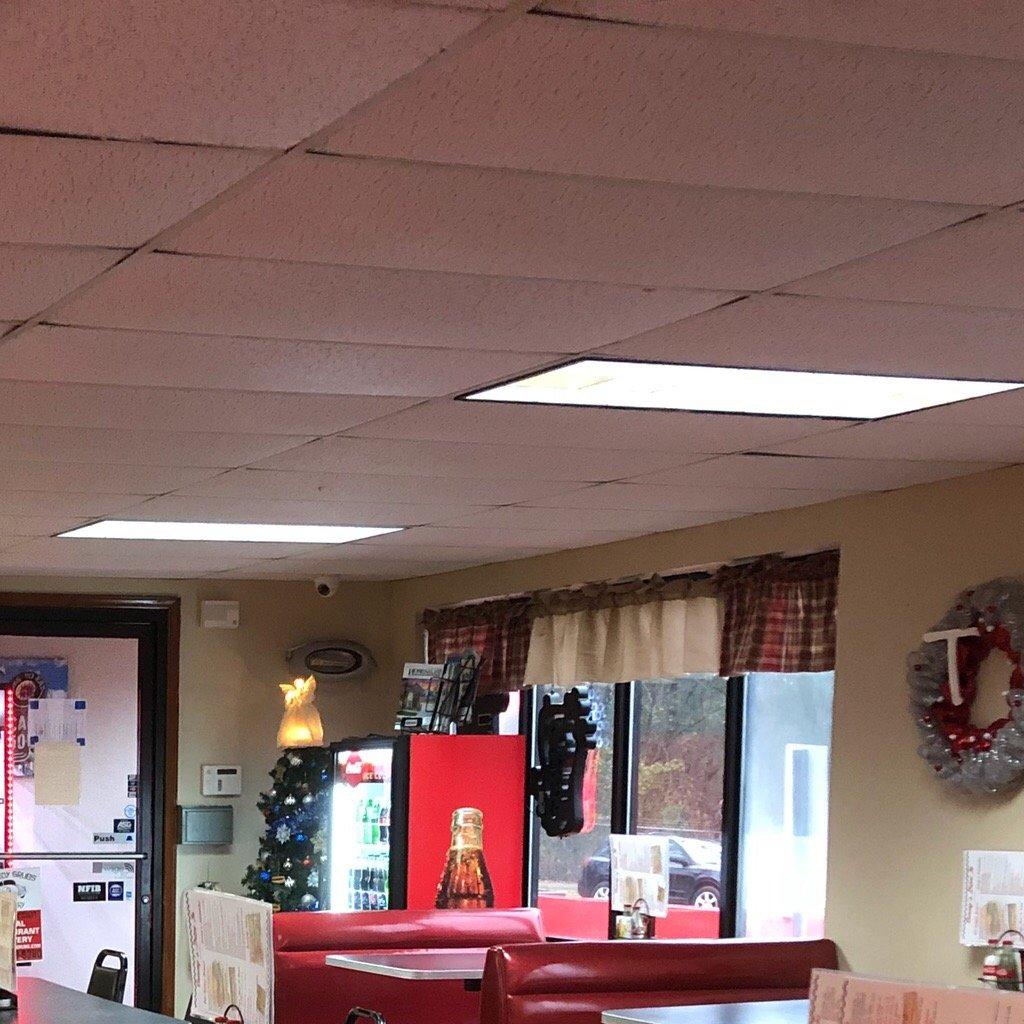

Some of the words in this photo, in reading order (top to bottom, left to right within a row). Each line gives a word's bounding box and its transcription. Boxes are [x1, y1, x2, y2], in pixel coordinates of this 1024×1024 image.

[923, 627, 980, 706] T
[77, 884, 101, 893] NFIB
[15, 920, 26, 928] AL
[15, 927, 40, 936] RANT
[15, 935, 33, 944] ERY
